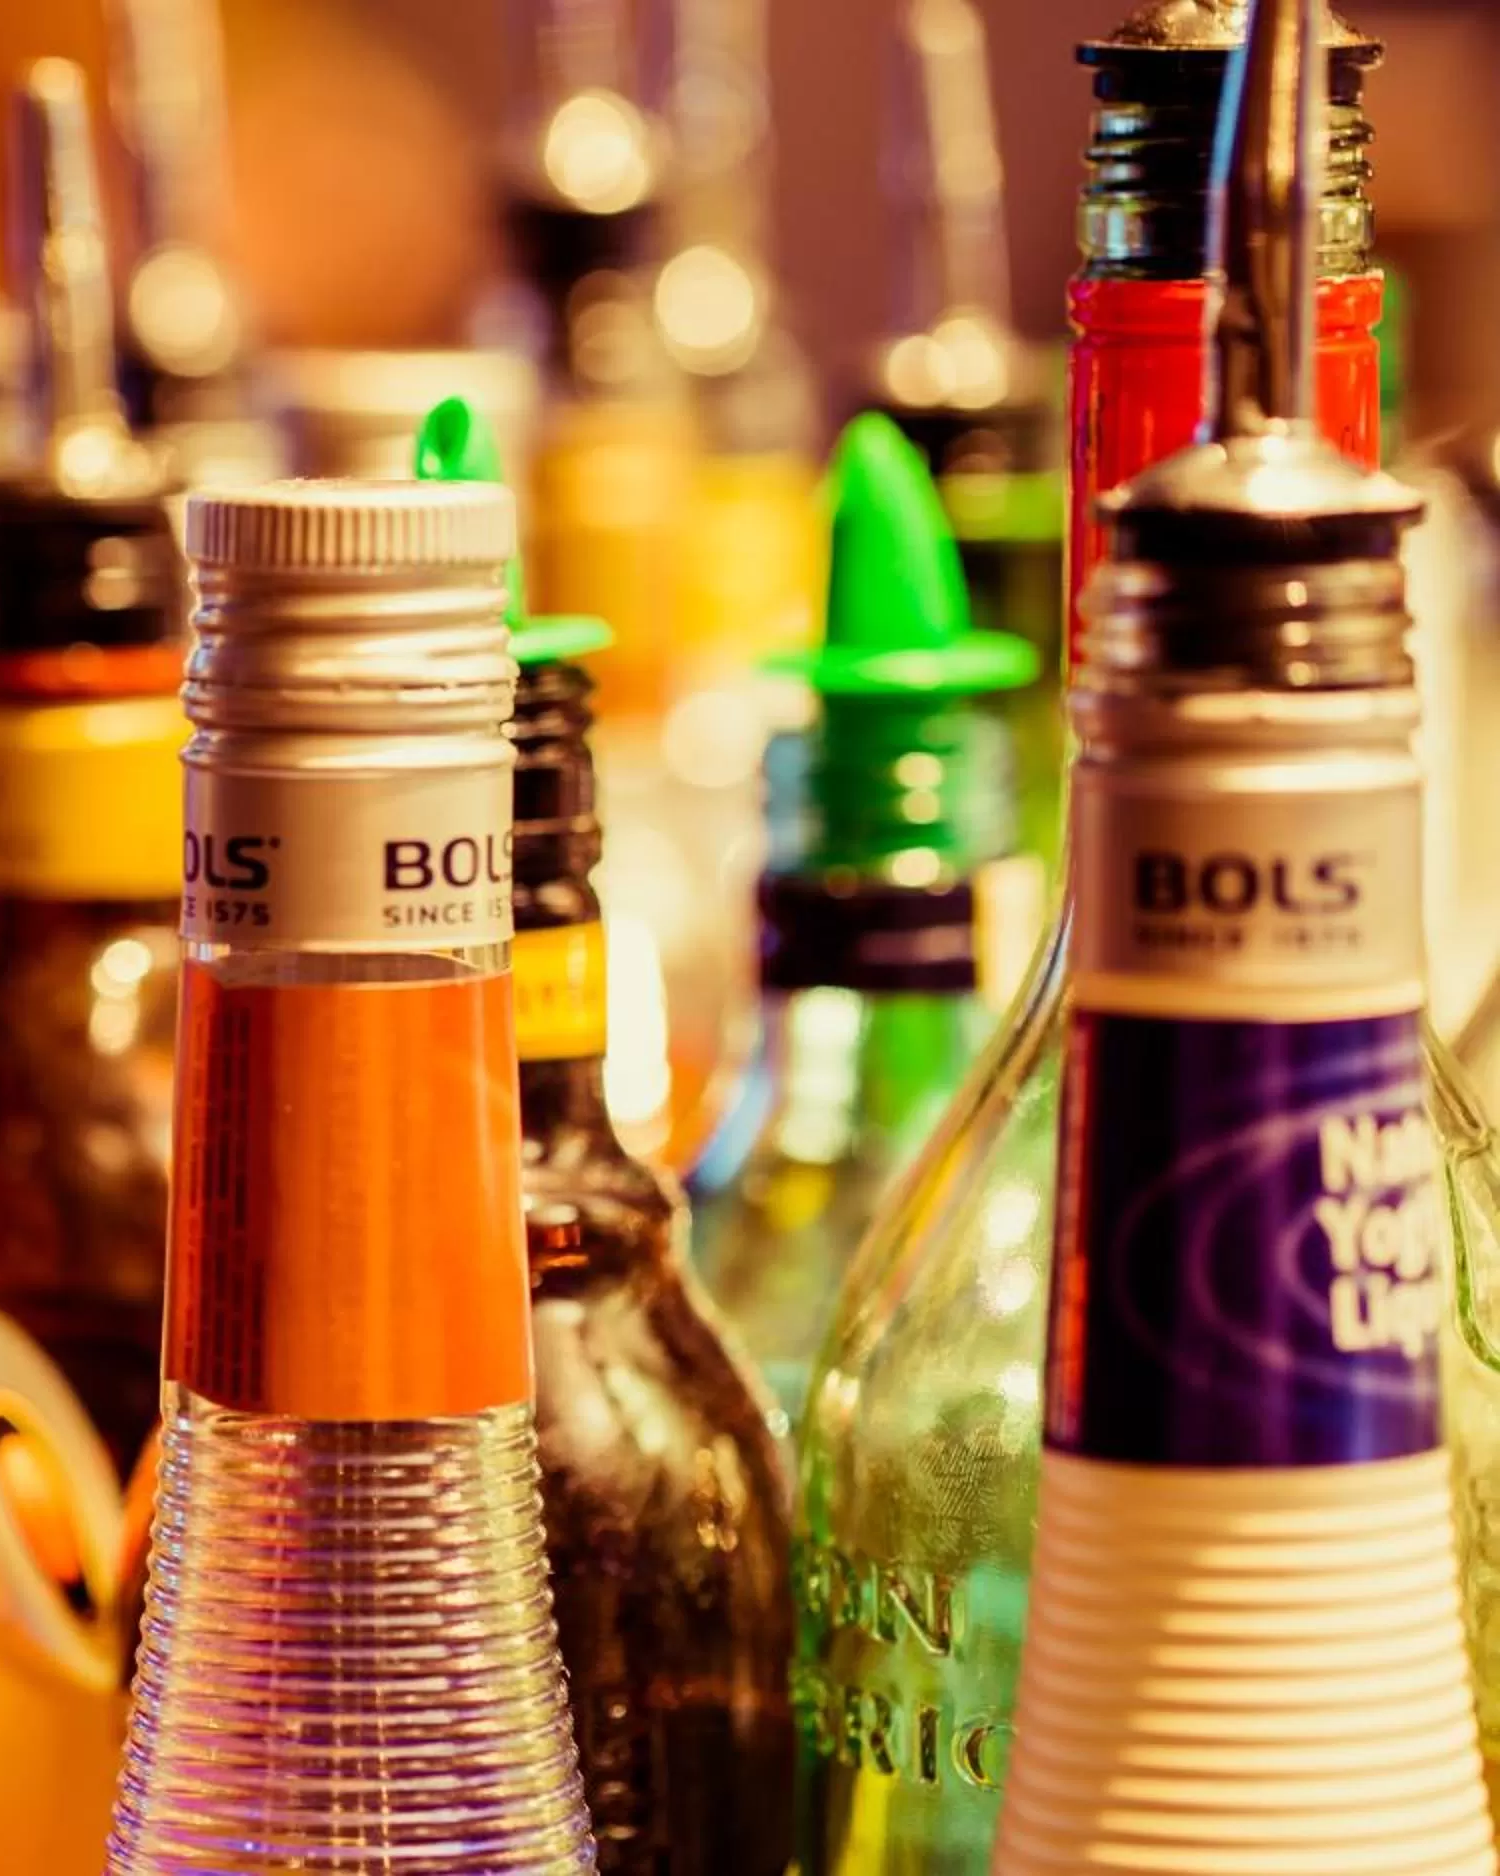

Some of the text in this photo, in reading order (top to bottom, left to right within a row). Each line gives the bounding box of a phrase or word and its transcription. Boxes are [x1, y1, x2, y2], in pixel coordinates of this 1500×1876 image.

[183, 831, 269, 890] OLS
[206, 899, 270, 926] 1575
[383, 901, 474, 928] SINCE
